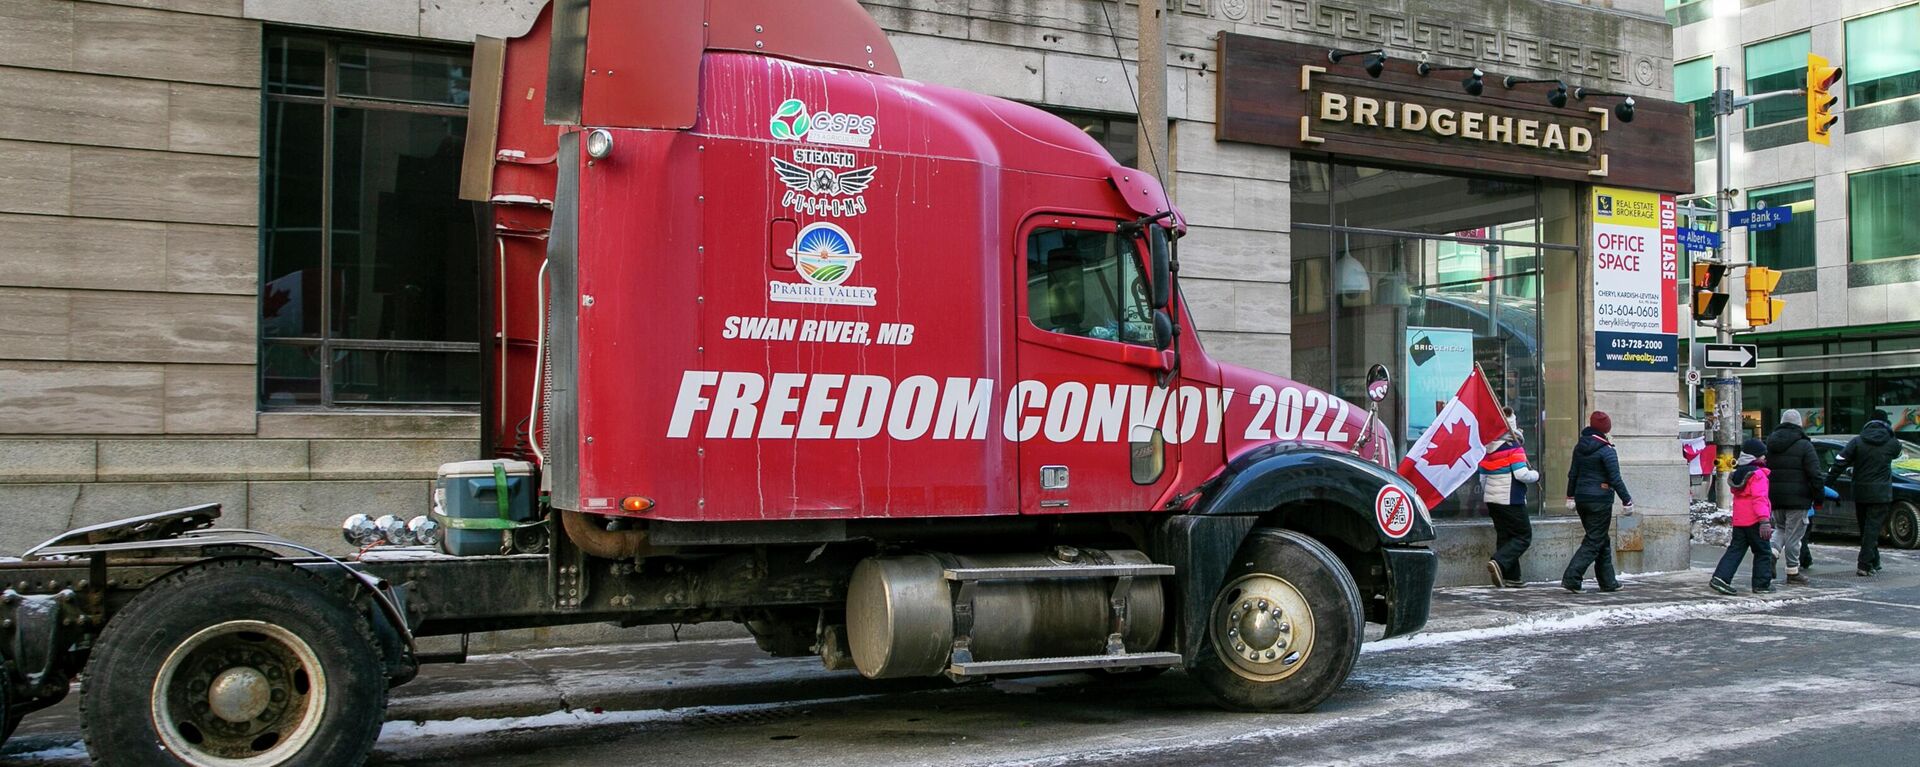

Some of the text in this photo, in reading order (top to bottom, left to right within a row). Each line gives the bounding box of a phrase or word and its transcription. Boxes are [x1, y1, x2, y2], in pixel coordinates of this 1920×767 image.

[812, 112, 875, 135] GSPS
[1320, 91, 1592, 153] BRIDGEHEAD
[795, 150, 854, 166] STEALTH
[1616, 200, 1654, 211] REAL ESTATE
[1616, 208, 1655, 219] BROKERAGE
[1751, 210, 1771, 223] Bank
[1598, 233, 1645, 252] OFFICE
[1661, 200, 1676, 280] FOR LEASE
[1686, 231, 1706, 244] Albert
[1598, 252, 1640, 271] SPACE
[773, 283, 875, 299] PRAIRIE VALLEY
[1598, 290, 1659, 300] CHERYL KARDISH-LEVITAN
[1598, 303, 1659, 318] 613-604-0608
[722, 316, 915, 346] SWAN RIVER, MB
[1414, 344, 1465, 353] BRIDGEHEAD
[1611, 338, 1663, 350] 613-728-2000
[1606, 351, 1669, 364] www.dvrealty.com
[666, 370, 1350, 445] FREEDOM CONVOY 2022
